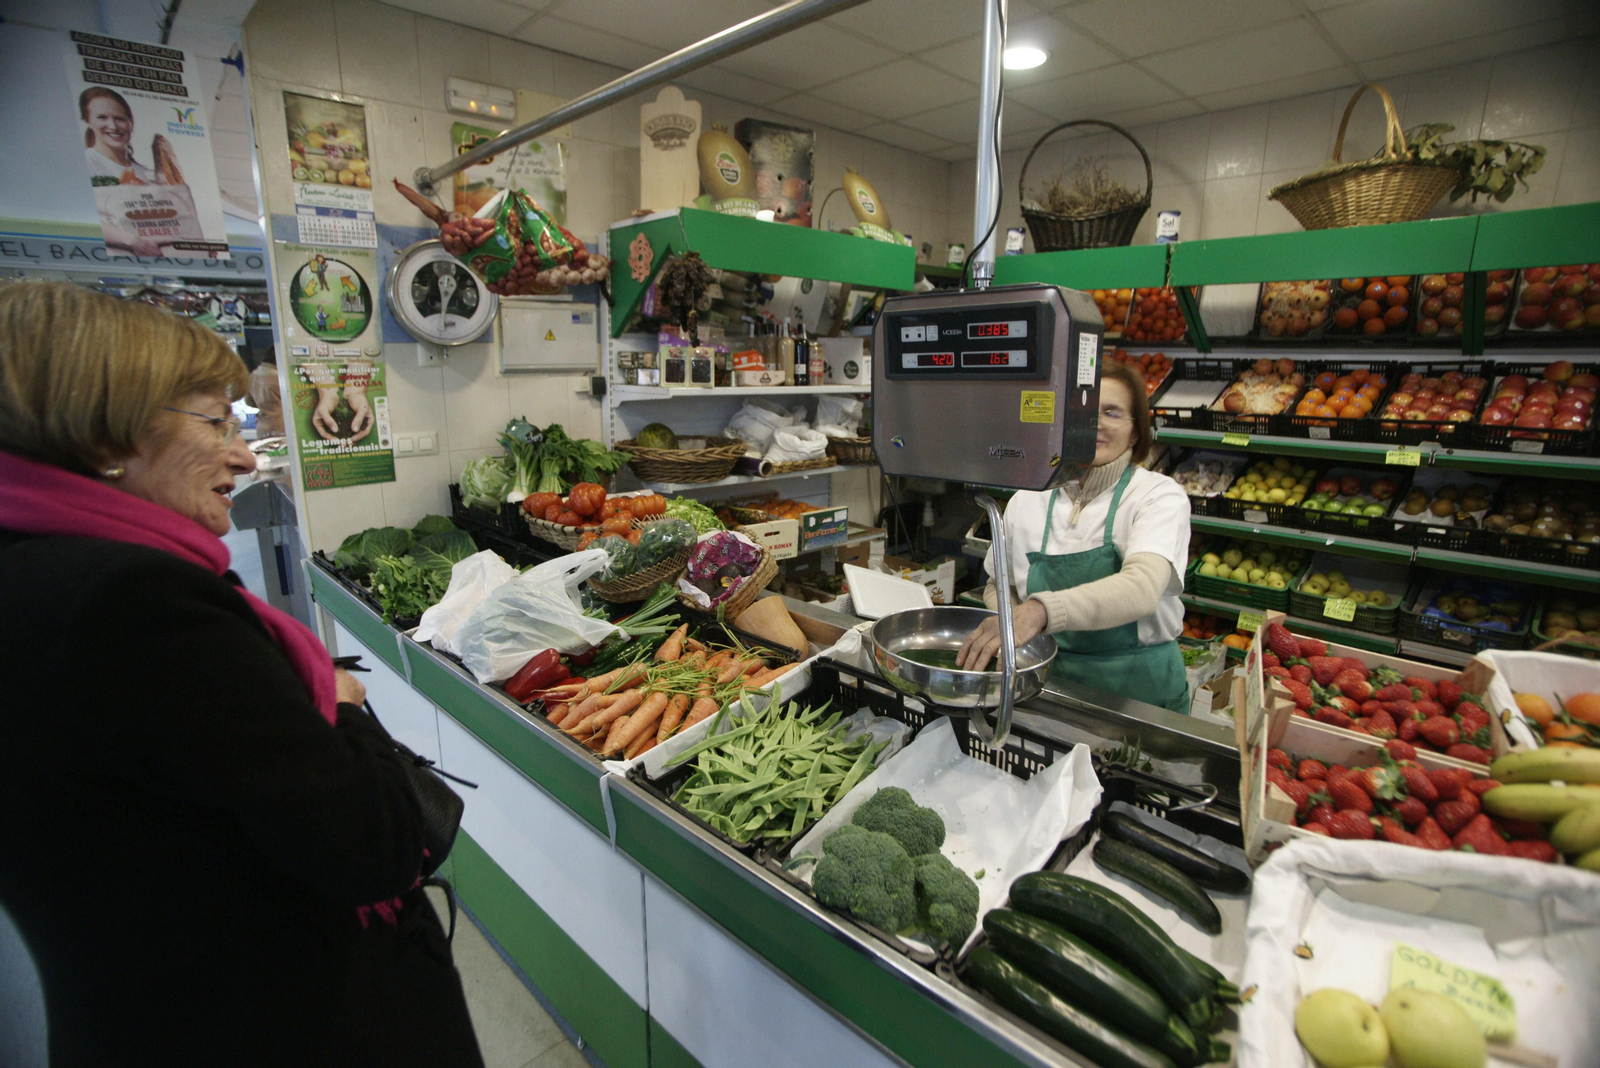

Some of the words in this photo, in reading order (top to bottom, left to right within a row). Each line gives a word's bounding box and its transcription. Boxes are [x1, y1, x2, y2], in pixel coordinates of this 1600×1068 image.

[74, 33, 112, 46] AGORA
[114, 40, 128, 50] NO
[132, 43, 181, 59] MERCADO
[80, 46, 133, 62] TRAVESAS
[136, 56, 180, 70] LEVARAS
[88, 60, 102, 69] DE
[105, 62, 139, 75] BALDE
[142, 68, 157, 78] UN
[159, 72, 180, 82] PAN
[86, 72, 132, 86] DEBAIXO
[135, 80, 149, 89] DO
[152, 83, 185, 95] BRAZO
[167, 122, 204, 131] mercado
[168, 127, 205, 137] travesas
[1162, 218, 1174, 227] Sal
[150, 227, 172, 236] BALDE
[1, 242, 40, 258] EL
[294, 367, 315, 375] ¿Por
[302, 437, 352, 448] Legumes
[320, 442, 379, 455] tradicionais
[303, 455, 336, 463] productos
[1397, 946, 1508, 1005] GOLDEN
